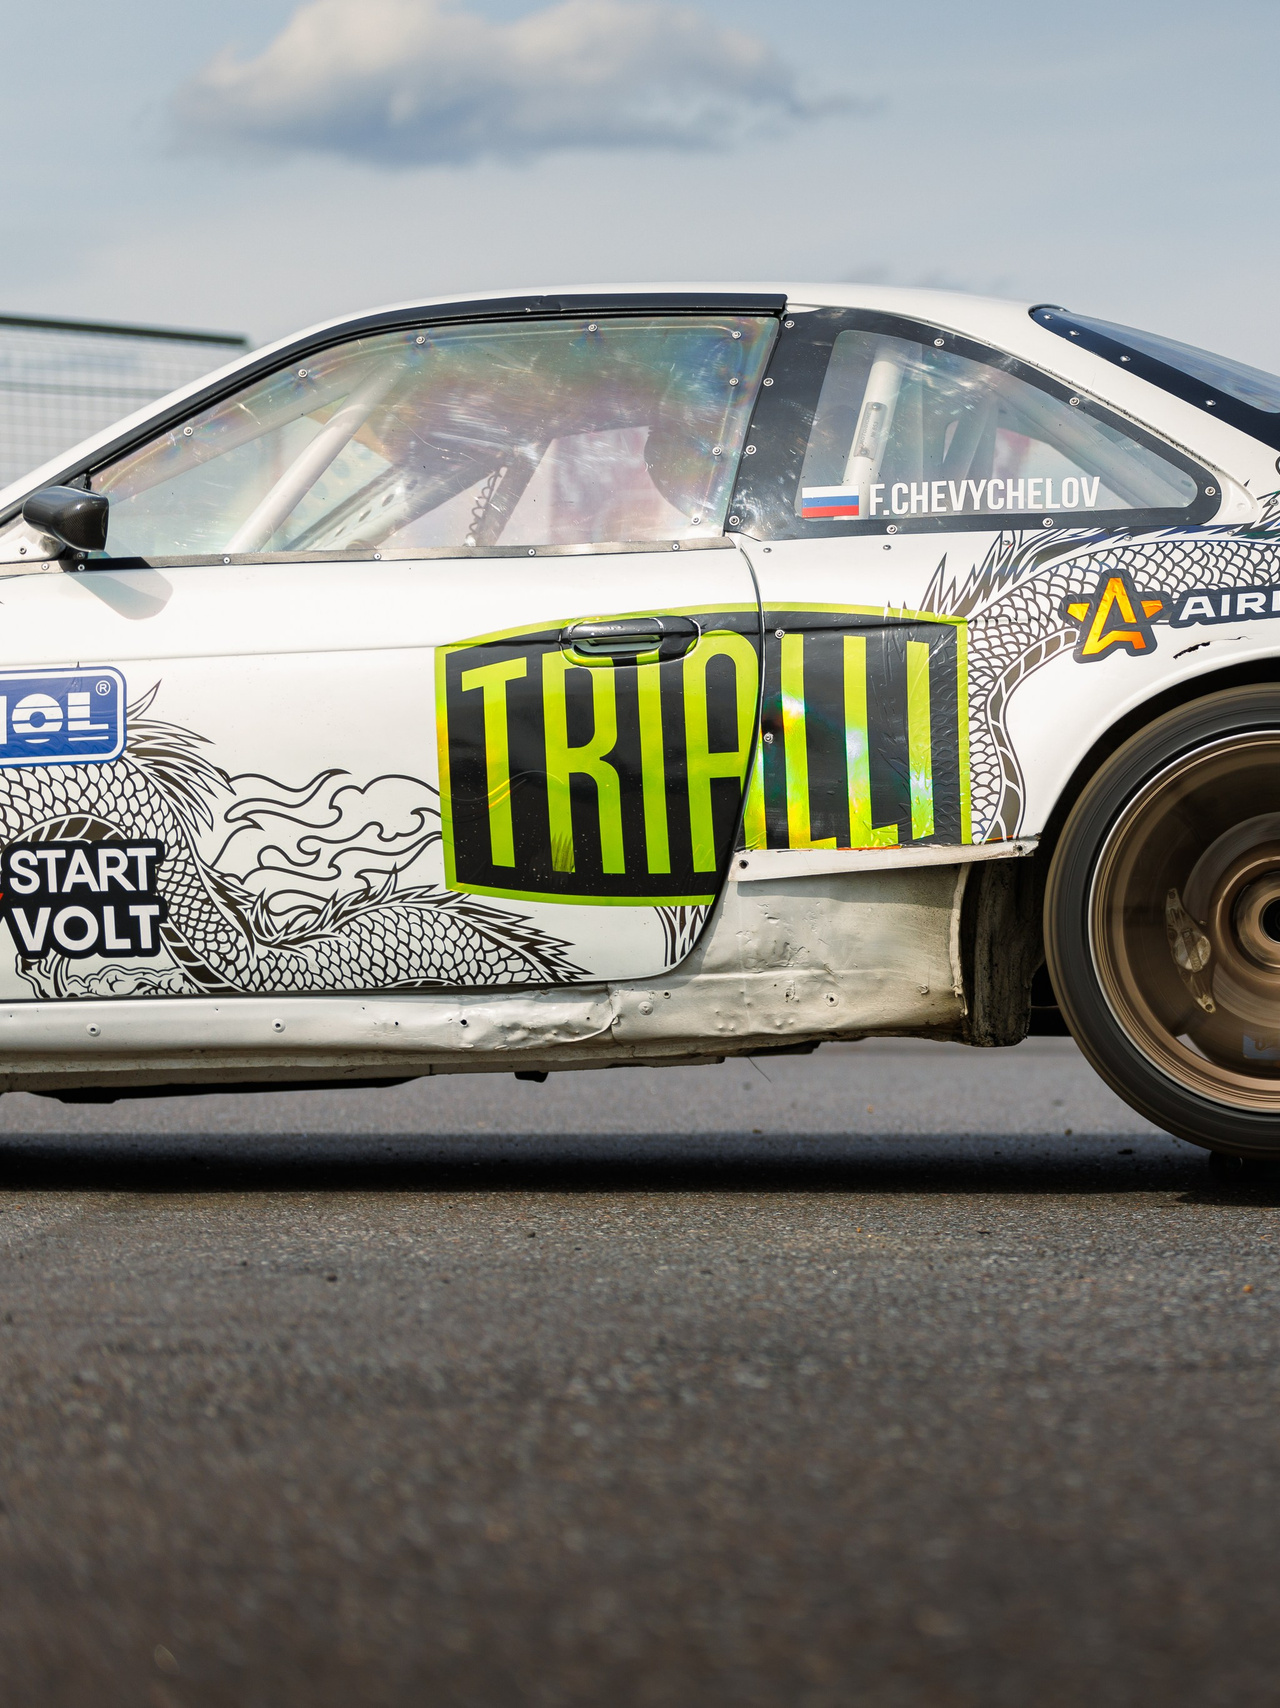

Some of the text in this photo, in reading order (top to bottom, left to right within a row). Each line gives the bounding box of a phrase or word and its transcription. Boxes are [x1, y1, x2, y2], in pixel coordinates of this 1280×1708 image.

[869, 476, 1101, 516] F.CHEVYCHELOV
[0, 691, 110, 745] OL
[460, 629, 935, 875] TRIALLI
[8, 847, 158, 895] START
[11, 904, 160, 952] VOLT
